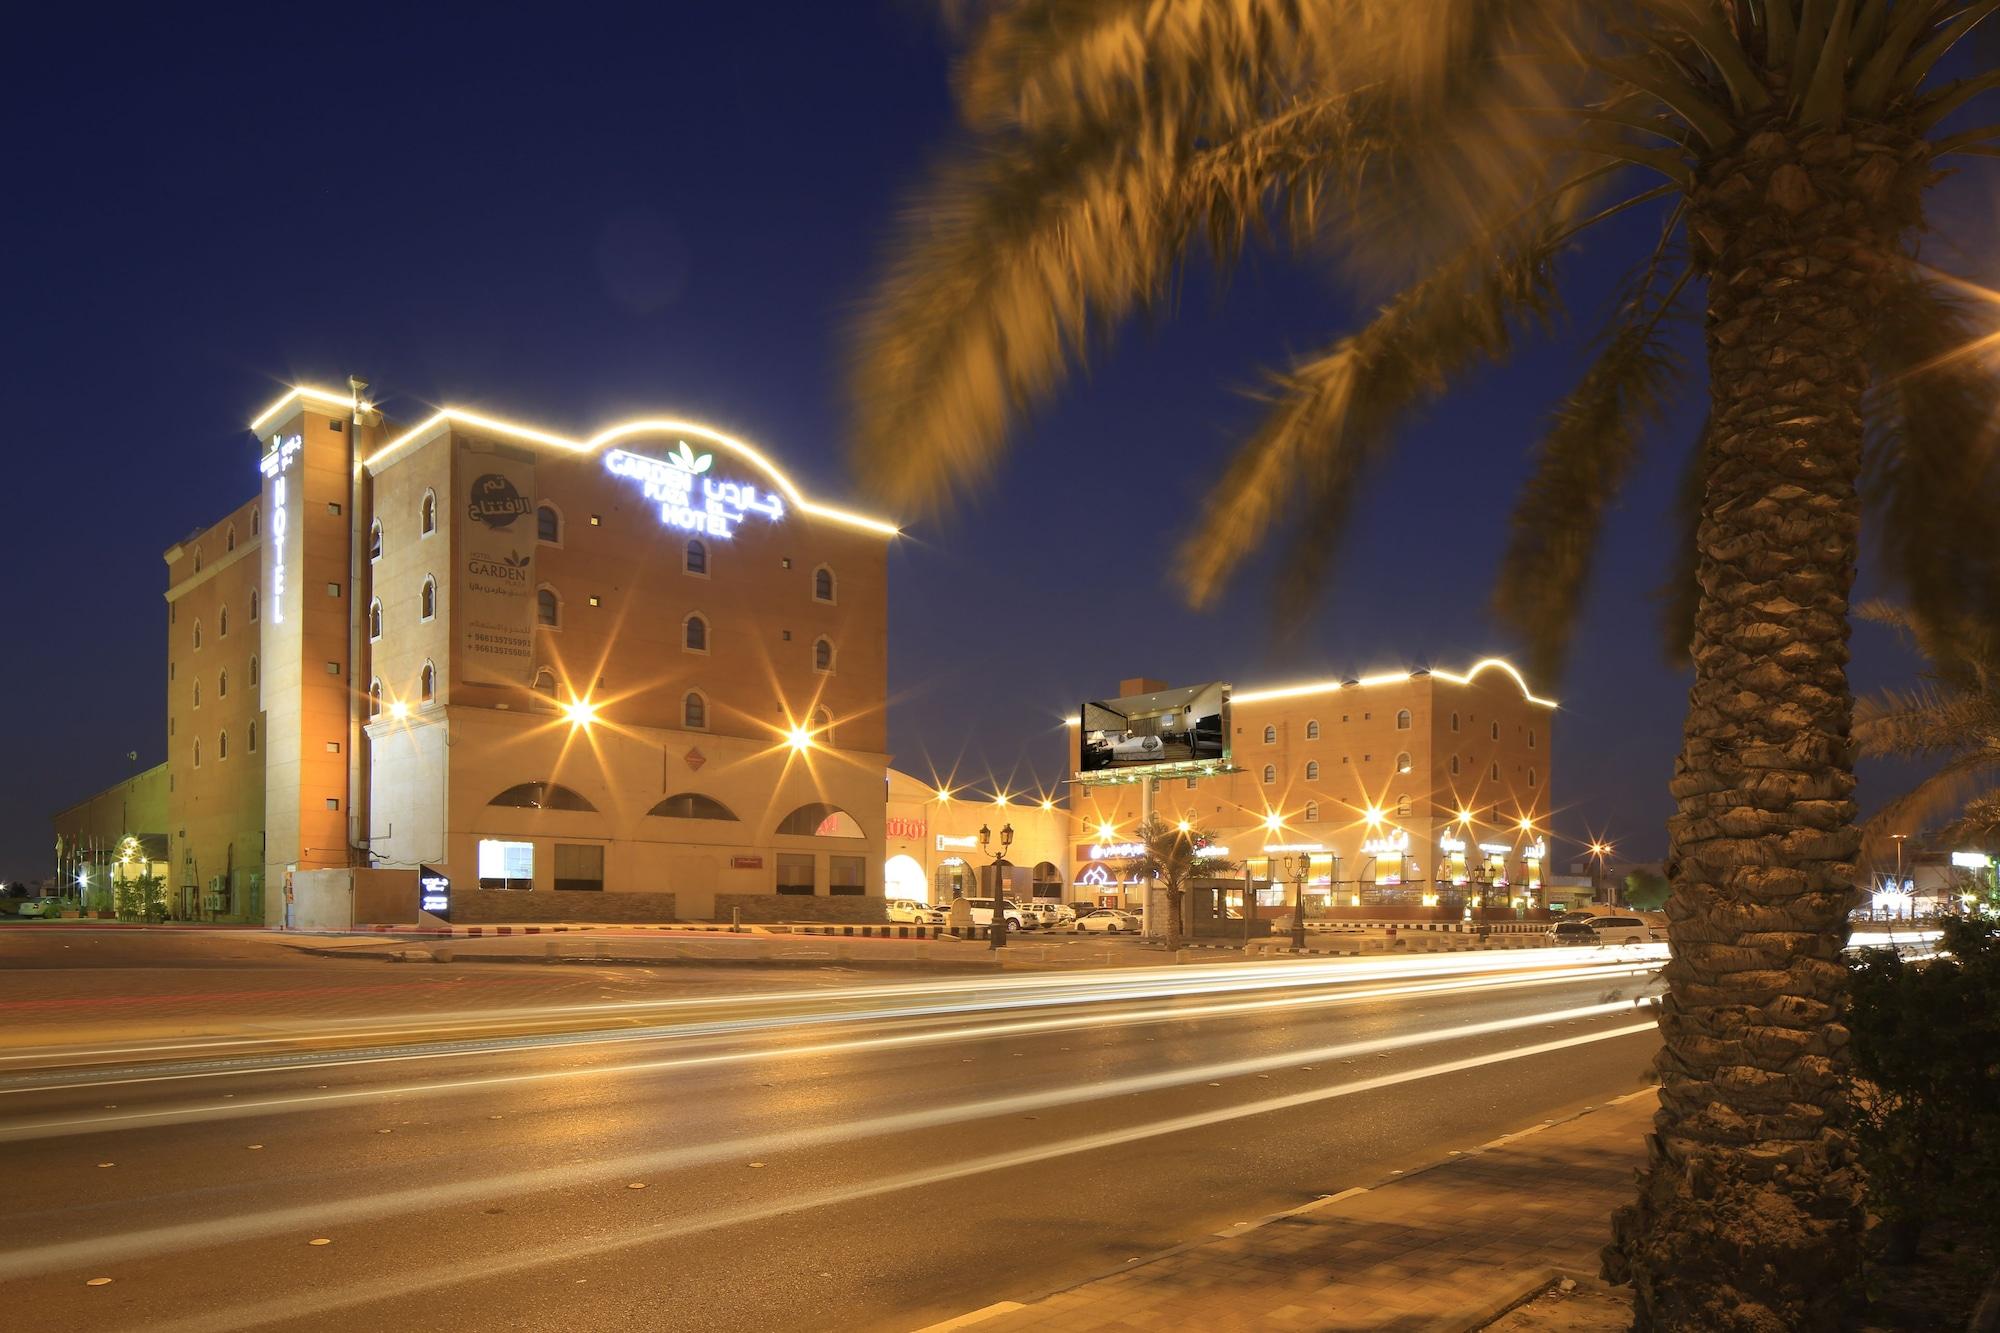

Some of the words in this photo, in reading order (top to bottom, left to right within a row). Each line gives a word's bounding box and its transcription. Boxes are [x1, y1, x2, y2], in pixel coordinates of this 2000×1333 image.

[483, 476, 505, 494] تم
[663, 503, 731, 537] HOTEL
[273, 476, 286, 624] HOTEL
[468, 561, 526, 582] GARDEN
